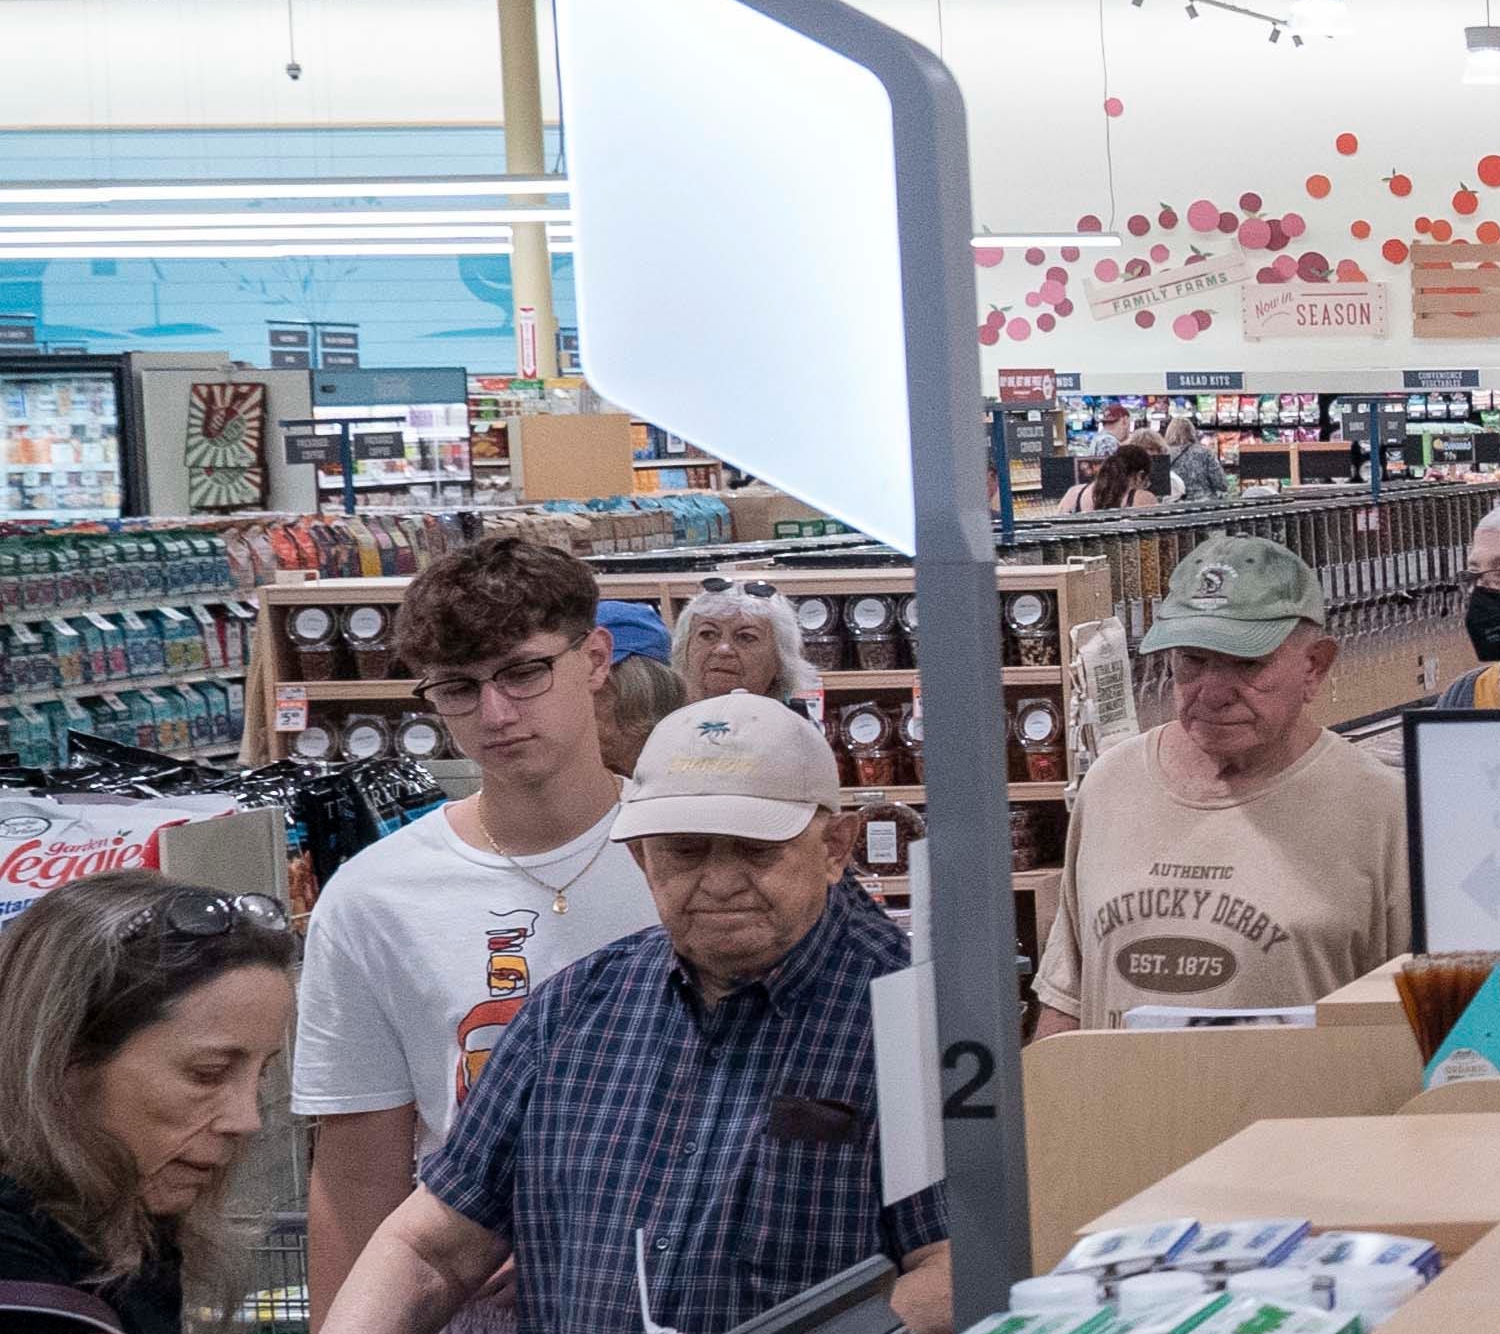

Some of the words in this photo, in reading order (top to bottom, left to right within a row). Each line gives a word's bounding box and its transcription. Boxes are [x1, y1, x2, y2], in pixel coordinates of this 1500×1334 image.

[1112, 288, 1169, 315] FAMILY
[1176, 271, 1229, 296] FARMS
[1254, 295, 1279, 319] Now
[1280, 290, 1294, 307] in
[1296, 302, 1372, 326] SEASON
[1179, 375, 1207, 387] SALAD
[1209, 375, 1231, 387] KITS
[45, 837, 109, 856] garden
[1149, 862, 1235, 880] AUTHENTIC
[1210, 892, 1290, 954] DERBY
[1129, 953, 1169, 975] EST.
[1175, 955, 1225, 977] 1875
[943, 1038, 997, 1121] 2
